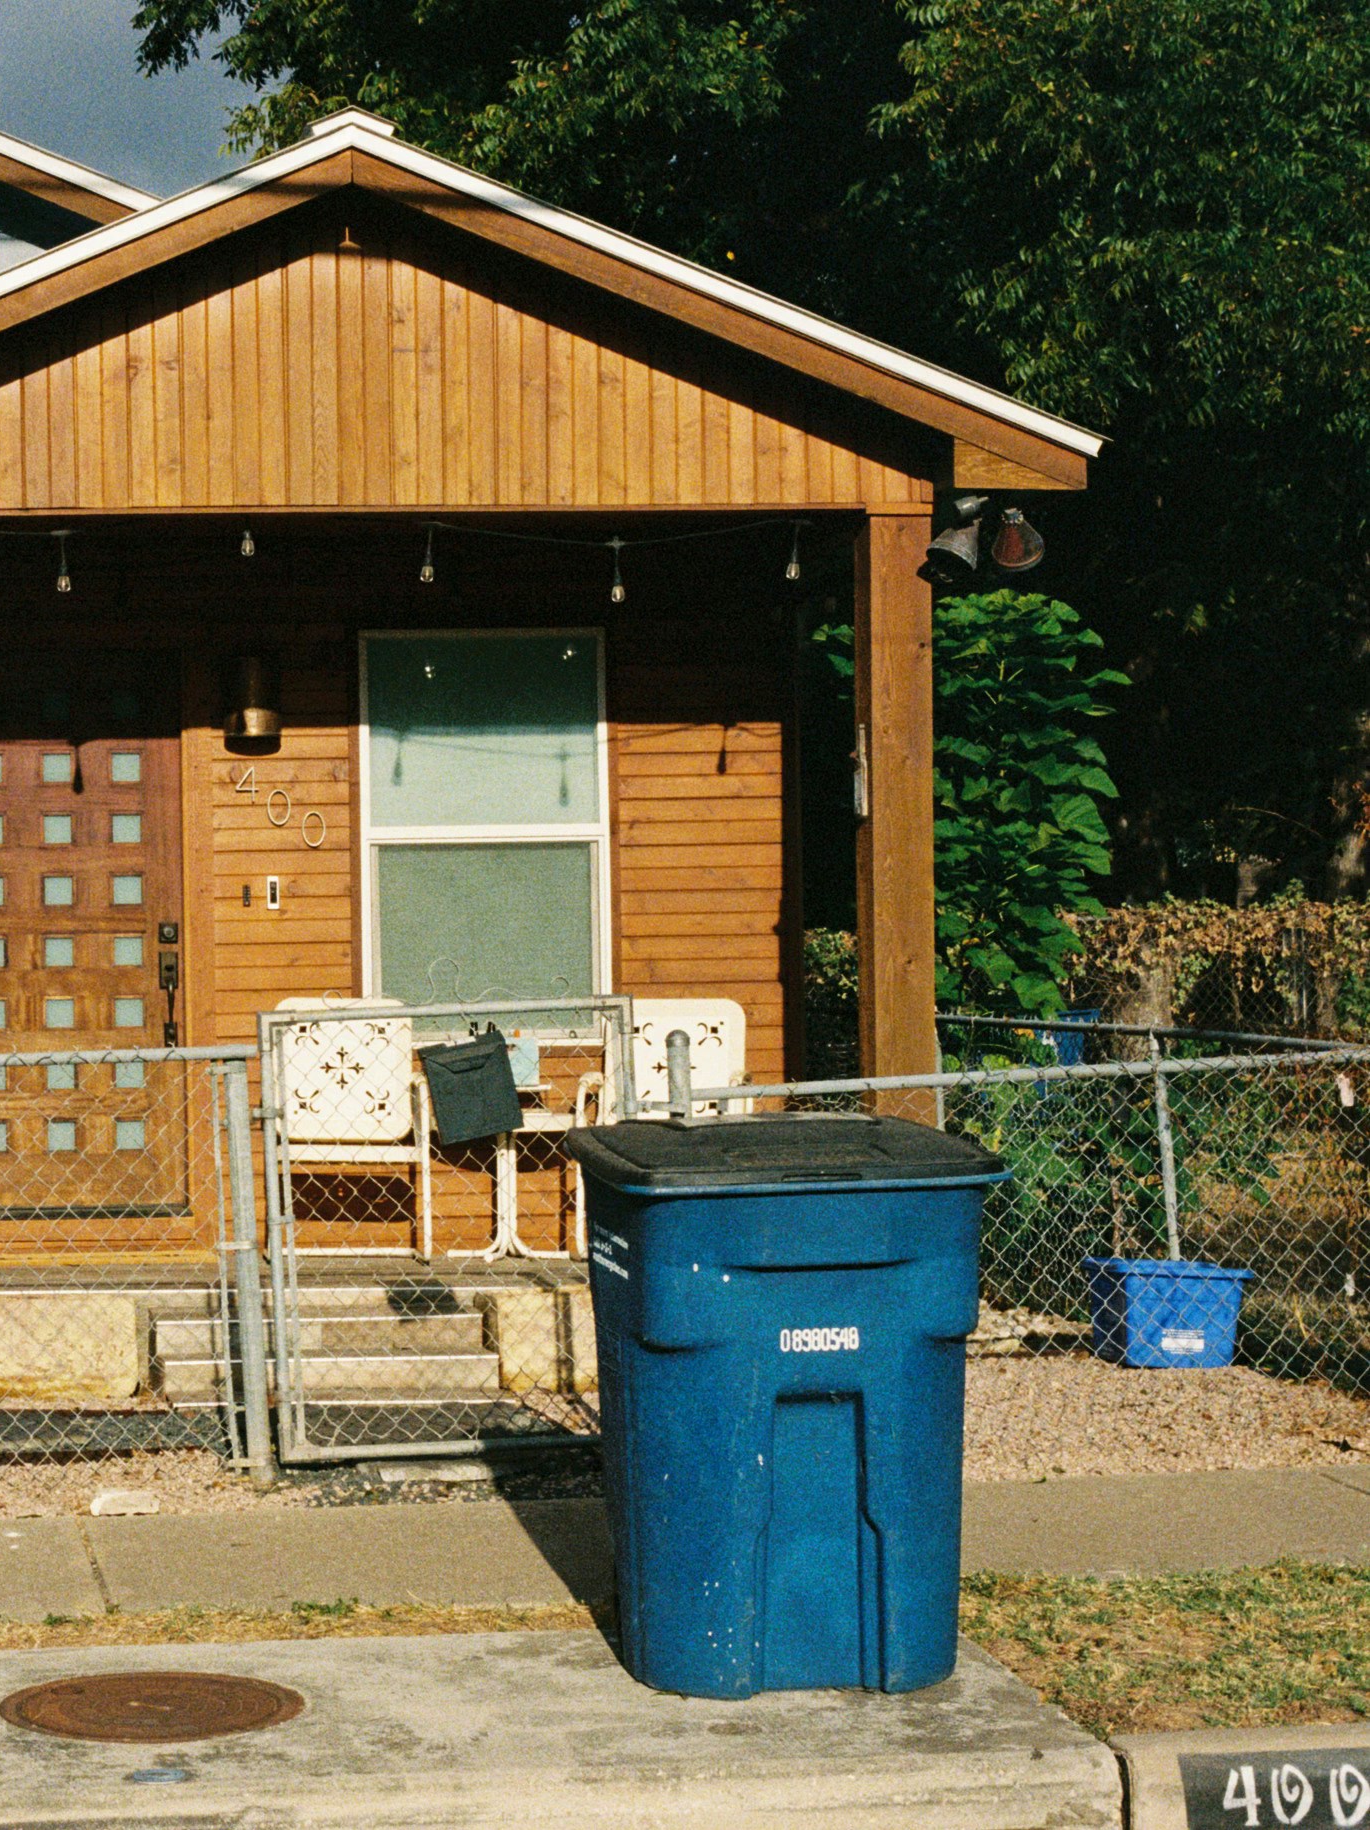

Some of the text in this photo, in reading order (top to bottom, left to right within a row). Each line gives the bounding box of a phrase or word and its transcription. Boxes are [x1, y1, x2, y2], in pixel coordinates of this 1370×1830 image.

[235, 765, 326, 848] 400
[780, 1327, 859, 1352] 08980548
[1223, 1763, 1370, 1827] 400
